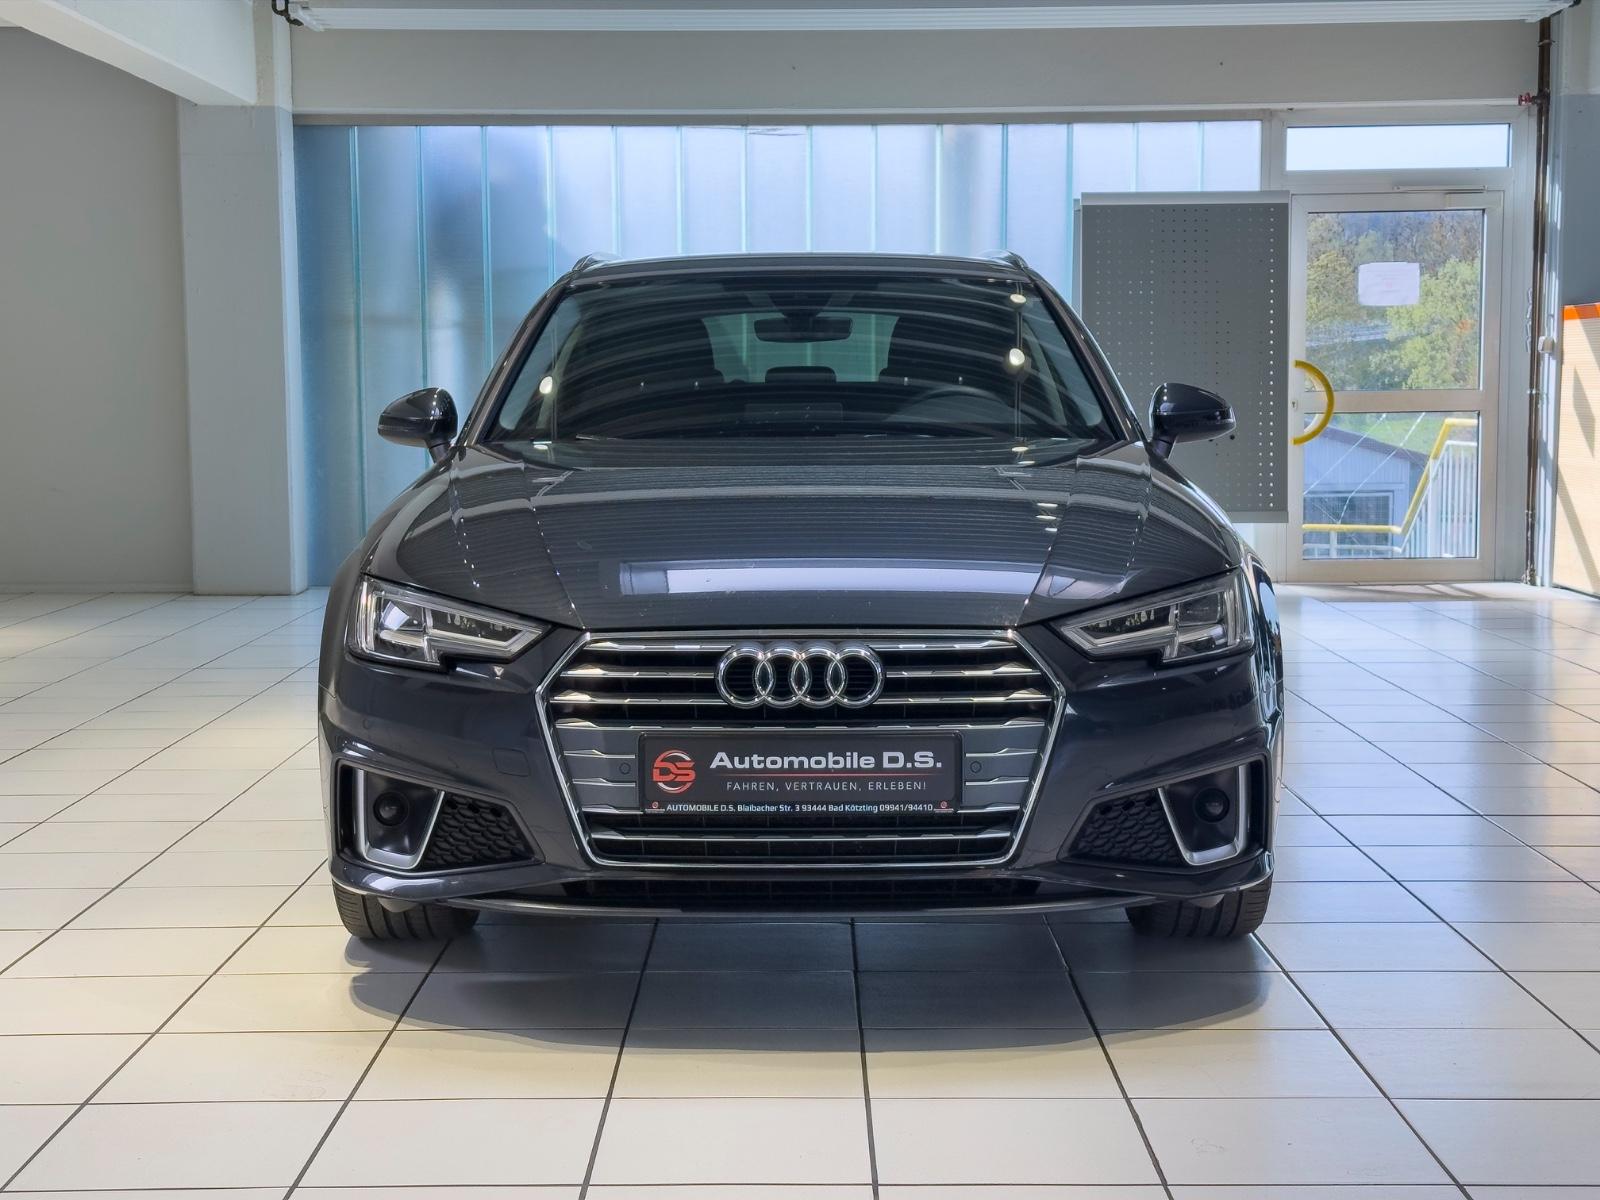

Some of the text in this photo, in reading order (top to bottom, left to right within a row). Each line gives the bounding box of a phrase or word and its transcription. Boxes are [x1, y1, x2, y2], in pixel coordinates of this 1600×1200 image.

[709, 751, 942, 769] Automobile D.S.
[726, 781, 927, 792] FAHREN, VERTRAUEN, ERLEBEN!
[666, 804, 719, 812] AUTOMOBILE
[737, 804, 778, 812] Blaibacher
[779, 804, 793, 812] Str.
[795, 804, 800, 812] 3
[801, 804, 827, 812] 93444
[828, 804, 844, 812] Bad
[845, 803, 878, 813] Kötzting
[879, 803, 933, 812] 09941/94410
